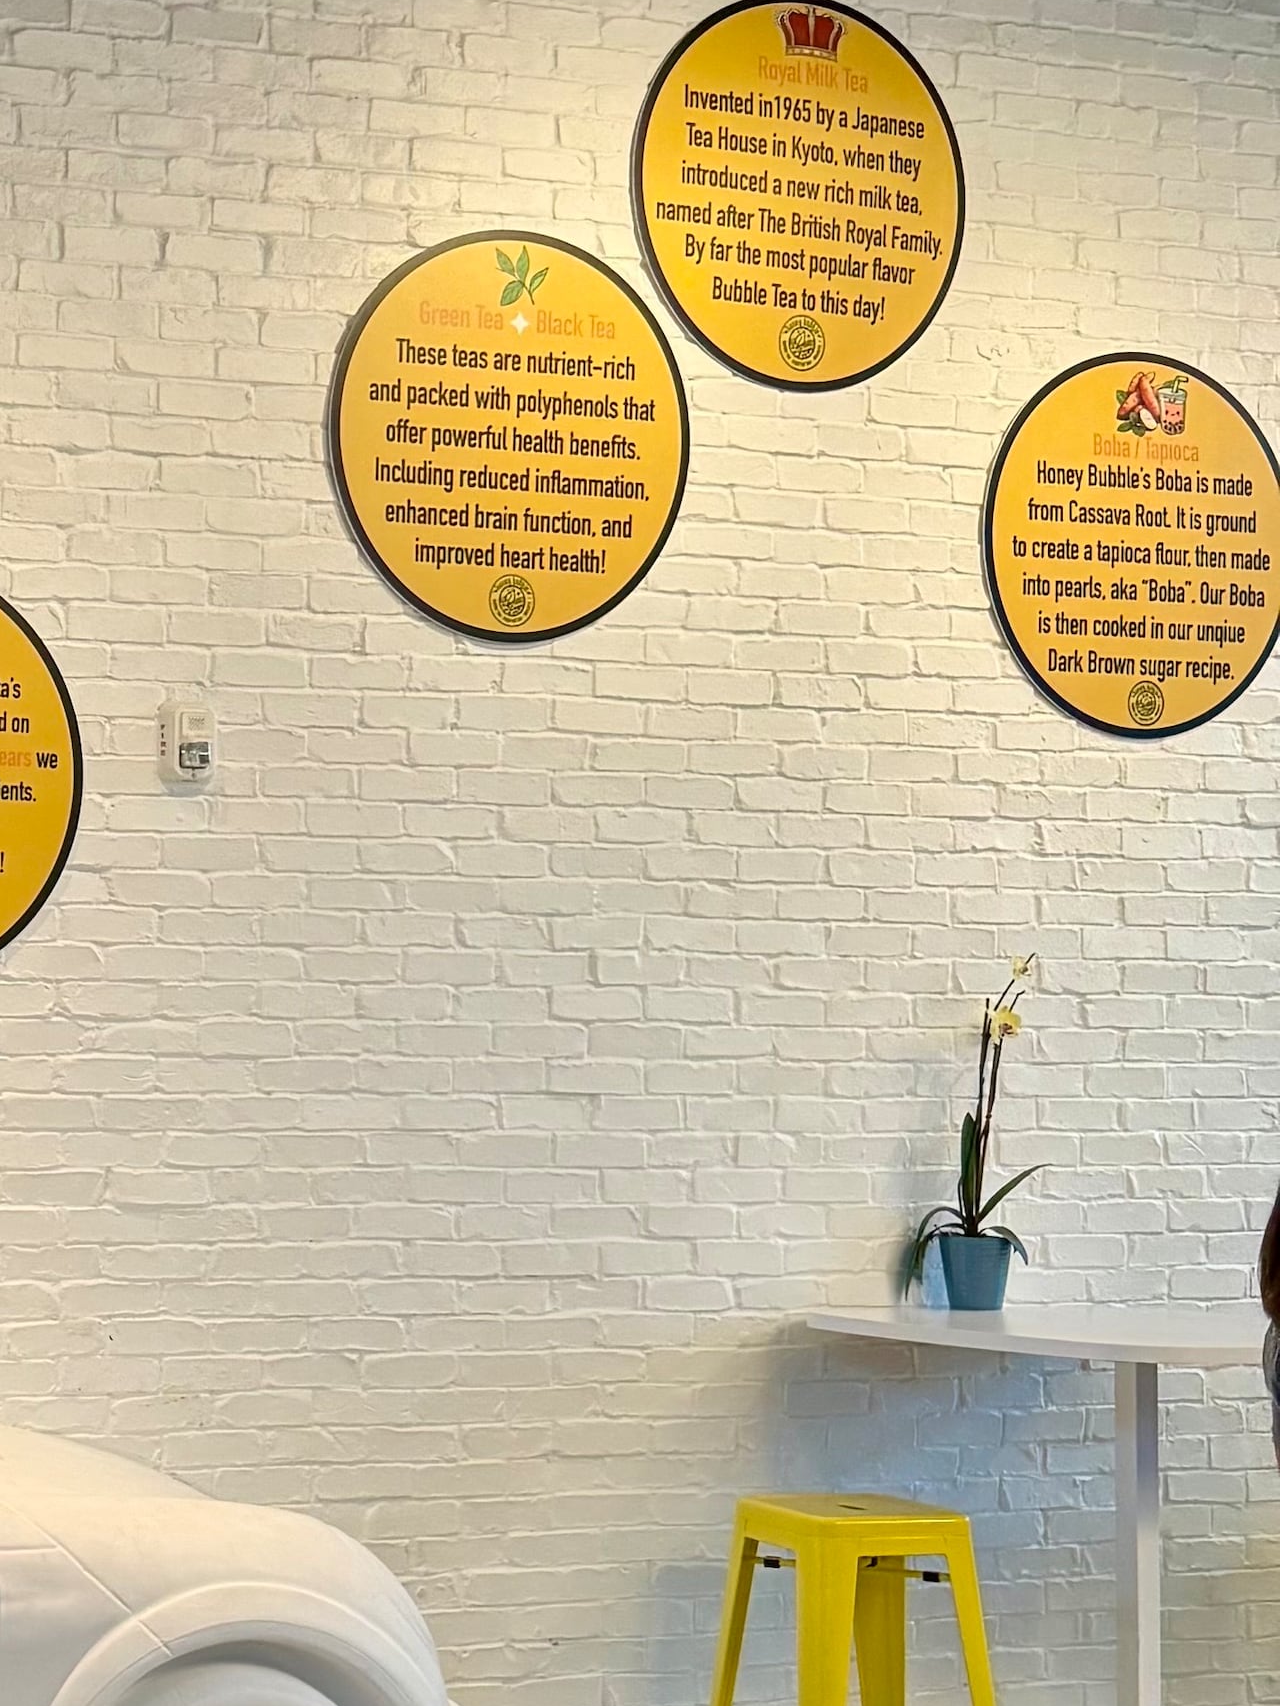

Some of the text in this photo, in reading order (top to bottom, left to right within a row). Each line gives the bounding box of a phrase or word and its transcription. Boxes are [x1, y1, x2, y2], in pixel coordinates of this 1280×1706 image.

[758, 55, 868, 93] Royal Milk Tea
[685, 84, 753, 115] Invented
[816, 101, 835, 132] by
[839, 111, 847, 128] a
[852, 107, 924, 139] Japanese
[686, 122, 921, 182] Tea House in Kyoto, when they
[682, 160, 922, 216] introduced a new rich milk tea,
[657, 202, 942, 260] named after The British Royal Family.
[686, 234, 915, 285] By far the most popular flavor
[419, 300, 615, 339] Green Tea Black Tea
[713, 276, 886, 325] Bubble Tea to this day!
[396, 338, 635, 380] These teas are nutrient-rich
[370, 378, 655, 421] and packed with polyphenols that
[386, 419, 640, 460] offer powerful health benefits.
[1093, 432, 1130, 458] Boba
[1144, 436, 1199, 465] Tapioca
[375, 457, 649, 501] Including reduced inflammation,
[1037, 460, 1252, 496] Honey Bubble's Boba is made
[386, 499, 632, 538] enhanced brain function, and
[1028, 497, 1063, 522] from
[1069, 500, 1130, 525] Cassava
[1177, 506, 1186, 529] It
[1190, 507, 1201, 530] is
[1206, 511, 1256, 537] ground
[415, 537, 606, 574] improved heart health!
[1012, 536, 1270, 571] to create a tapioca flour, then made
[1023, 572, 1050, 596] into
[1055, 576, 1105, 603] pearls,
[1111, 577, 1137, 600] aka
[1200, 581, 1226, 605] Our
[1230, 583, 1265, 607] Boba
[1039, 610, 1245, 648] is then cooked in our unqiue
[1048, 648, 1234, 685] Dark Brown sugar recipe.
[12, 717, 29, 733] on
[36, 752, 58, 769] we
